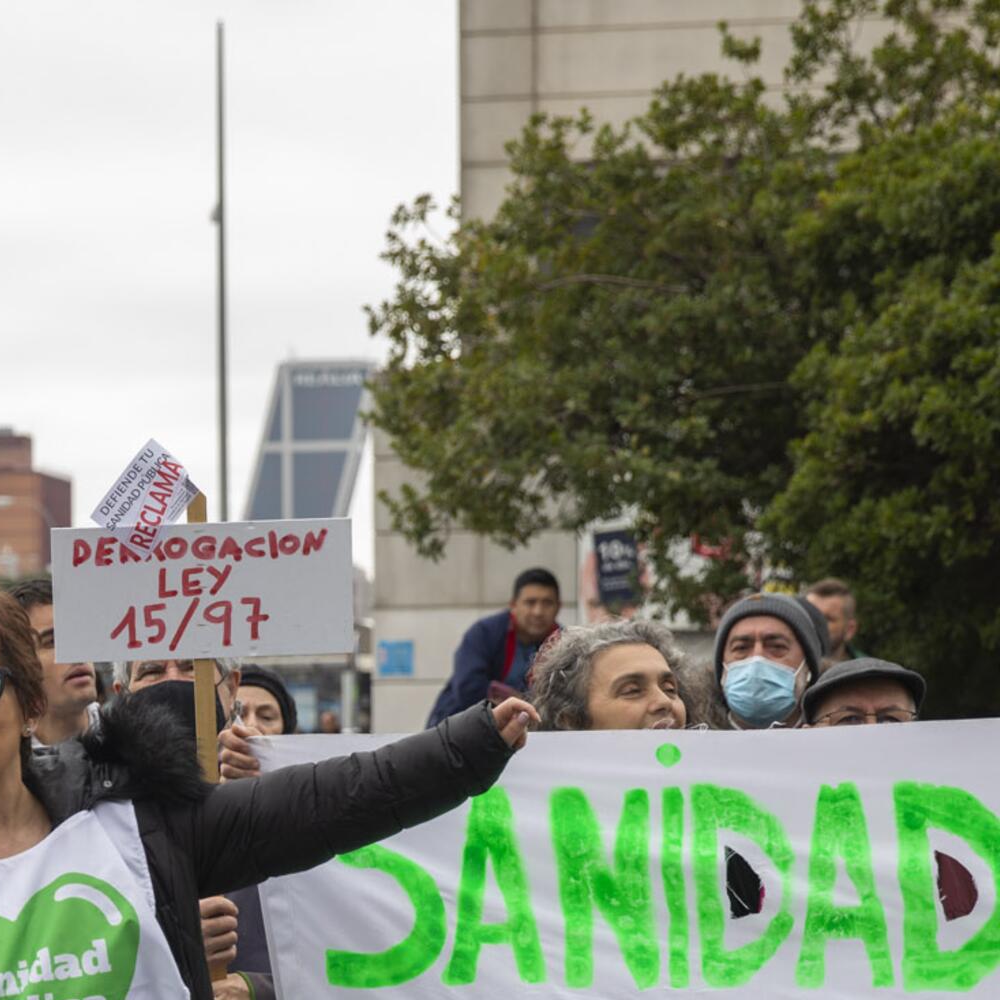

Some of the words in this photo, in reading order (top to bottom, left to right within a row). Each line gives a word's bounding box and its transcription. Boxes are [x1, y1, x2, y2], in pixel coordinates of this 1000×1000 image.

[100, 463, 143, 516] DEFIENDE
[138, 448, 155, 464] TU
[106, 488, 142, 532] SANIDAD
[129, 460, 183, 550] RECLAMA
[158, 565, 232, 599] LEY
[110, 596, 270, 652] 15/97
